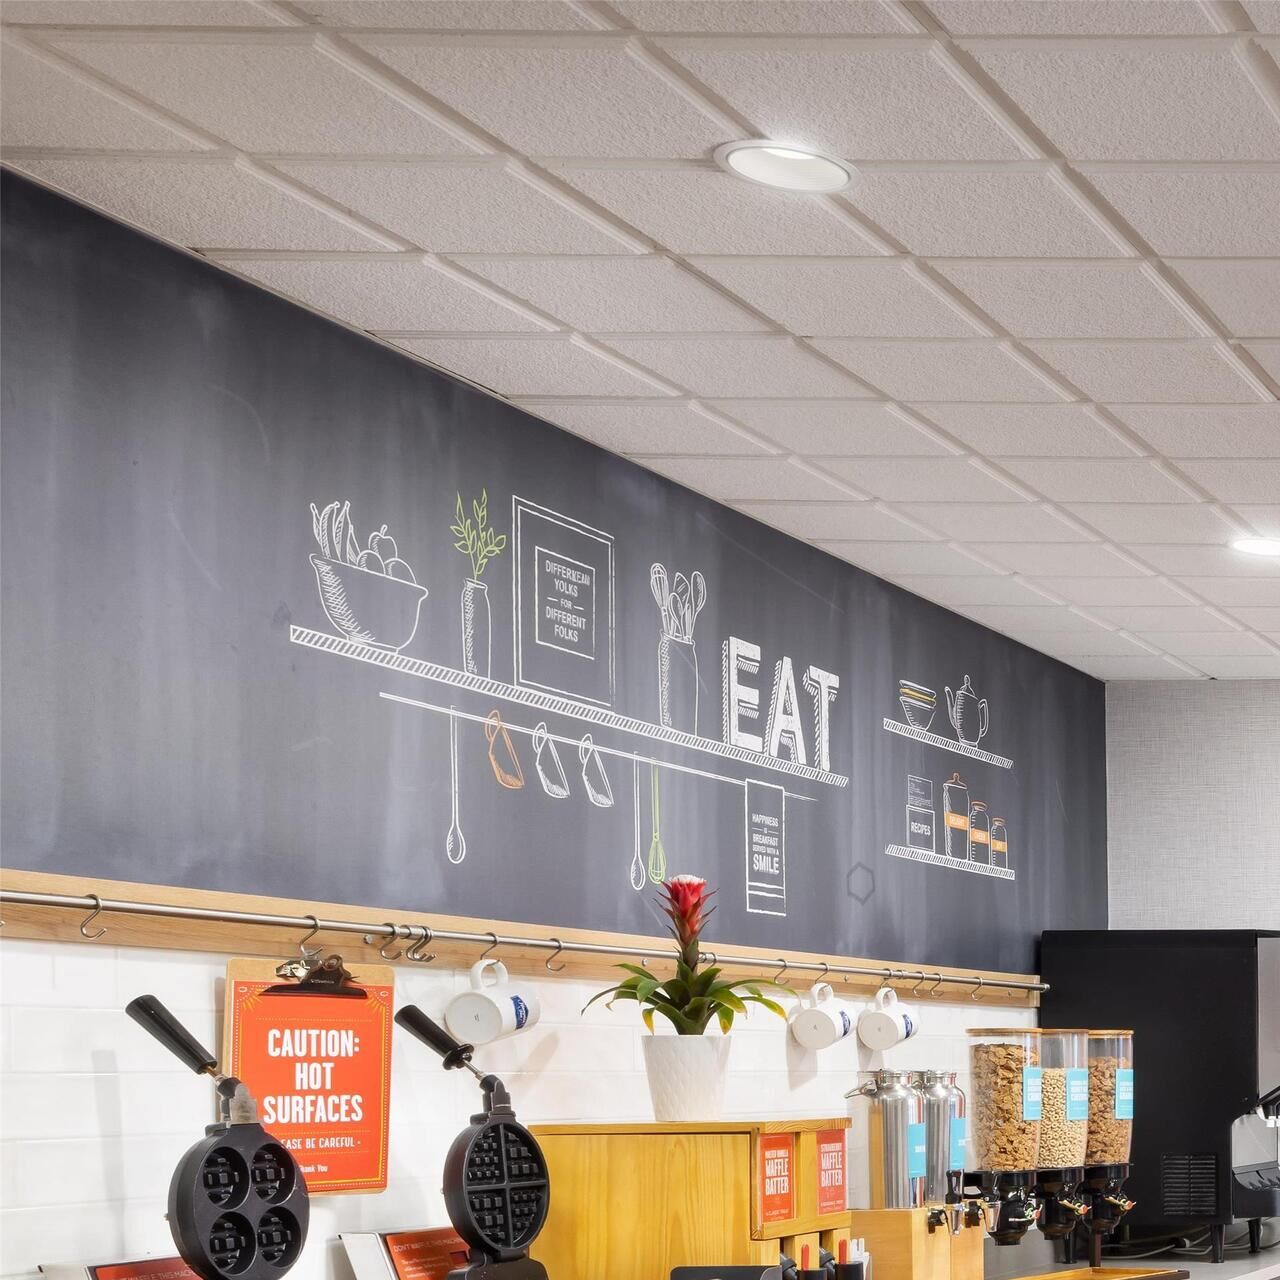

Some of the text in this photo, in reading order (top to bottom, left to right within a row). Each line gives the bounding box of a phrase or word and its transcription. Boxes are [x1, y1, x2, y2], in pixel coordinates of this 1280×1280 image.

[554, 578, 578, 597] YOLKS
[560, 598, 572, 610] FOR
[545, 606, 587, 630] DIFFERENT
[554, 624, 578, 642] FOLKS
[722, 636, 840, 772] EAT
[911, 822, 931, 836] RECIPES
[752, 854, 780, 875] SMILE
[267, 1029, 360, 1057] CAUTION:
[295, 1062, 334, 1090] HOT
[263, 1095, 363, 1124] SURFACES
[306, 1138, 316, 1149] BE
[319, 1137, 355, 1148] CAREFUL
[765, 1158, 789, 1177] WAFFLE
[821, 1152, 842, 1170] WAFFLE
[765, 1176, 789, 1196] BATTER
[821, 1169, 842, 1188] BATTER
